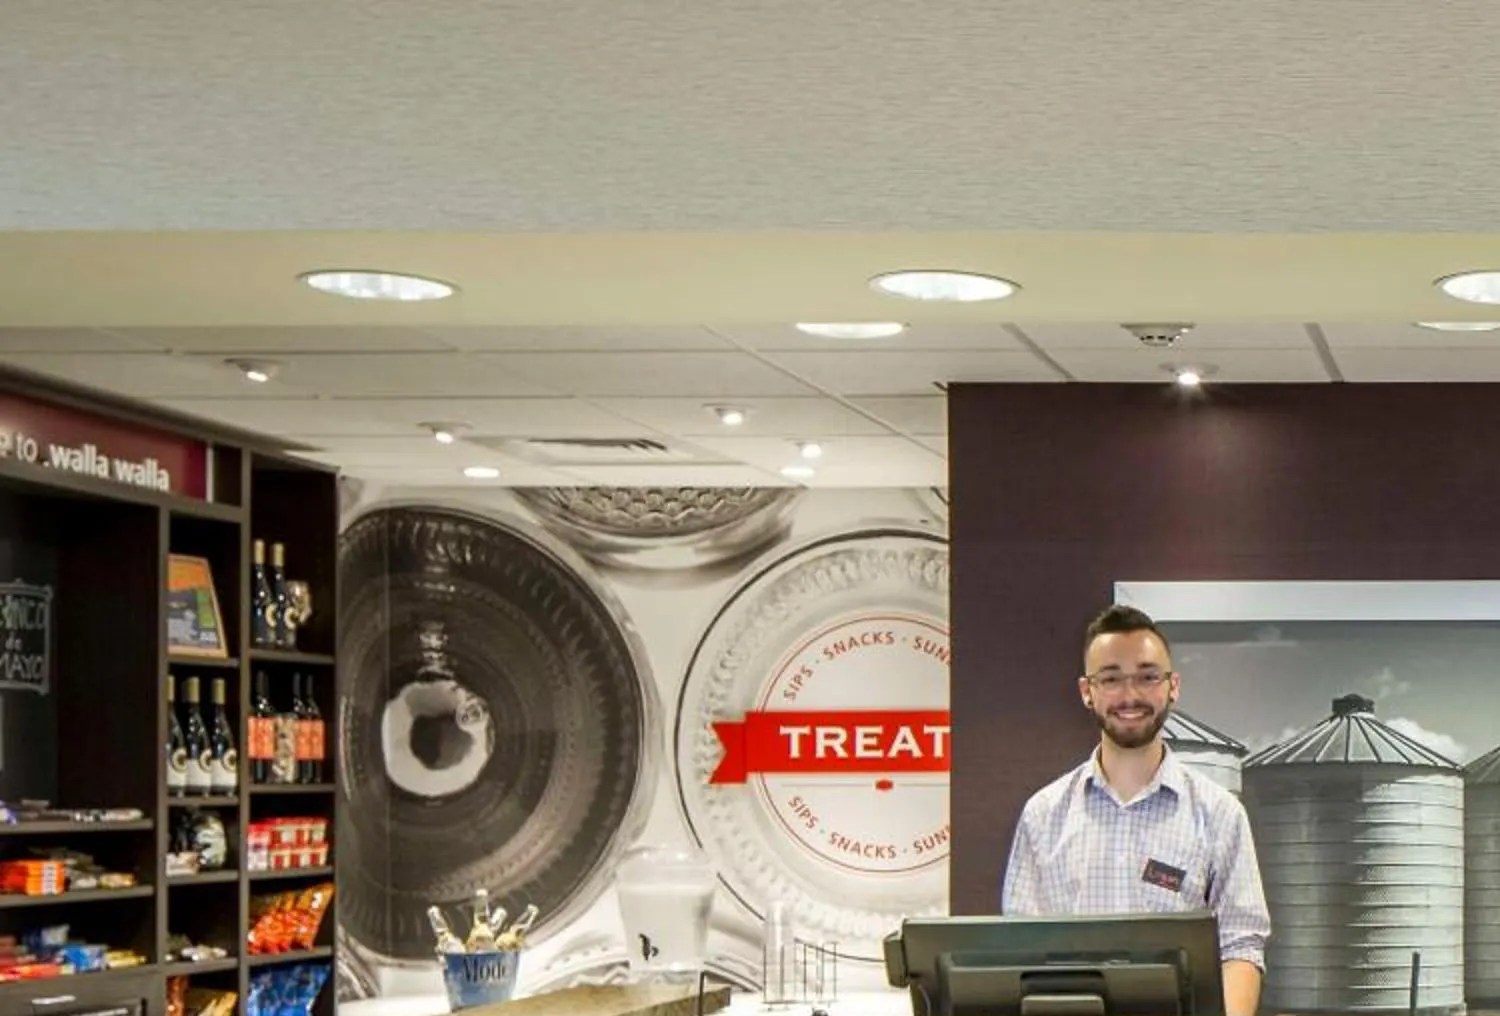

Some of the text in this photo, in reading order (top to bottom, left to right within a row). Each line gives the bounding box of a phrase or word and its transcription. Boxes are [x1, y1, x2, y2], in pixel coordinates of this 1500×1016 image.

[16, 432, 38, 463] to
[113, 458, 170, 492] walla
[784, 631, 950, 701] SIPS SNACKS SUN
[779, 725, 950, 758] TREAT
[788, 796, 950, 859] SIPS SNACKS SUN
